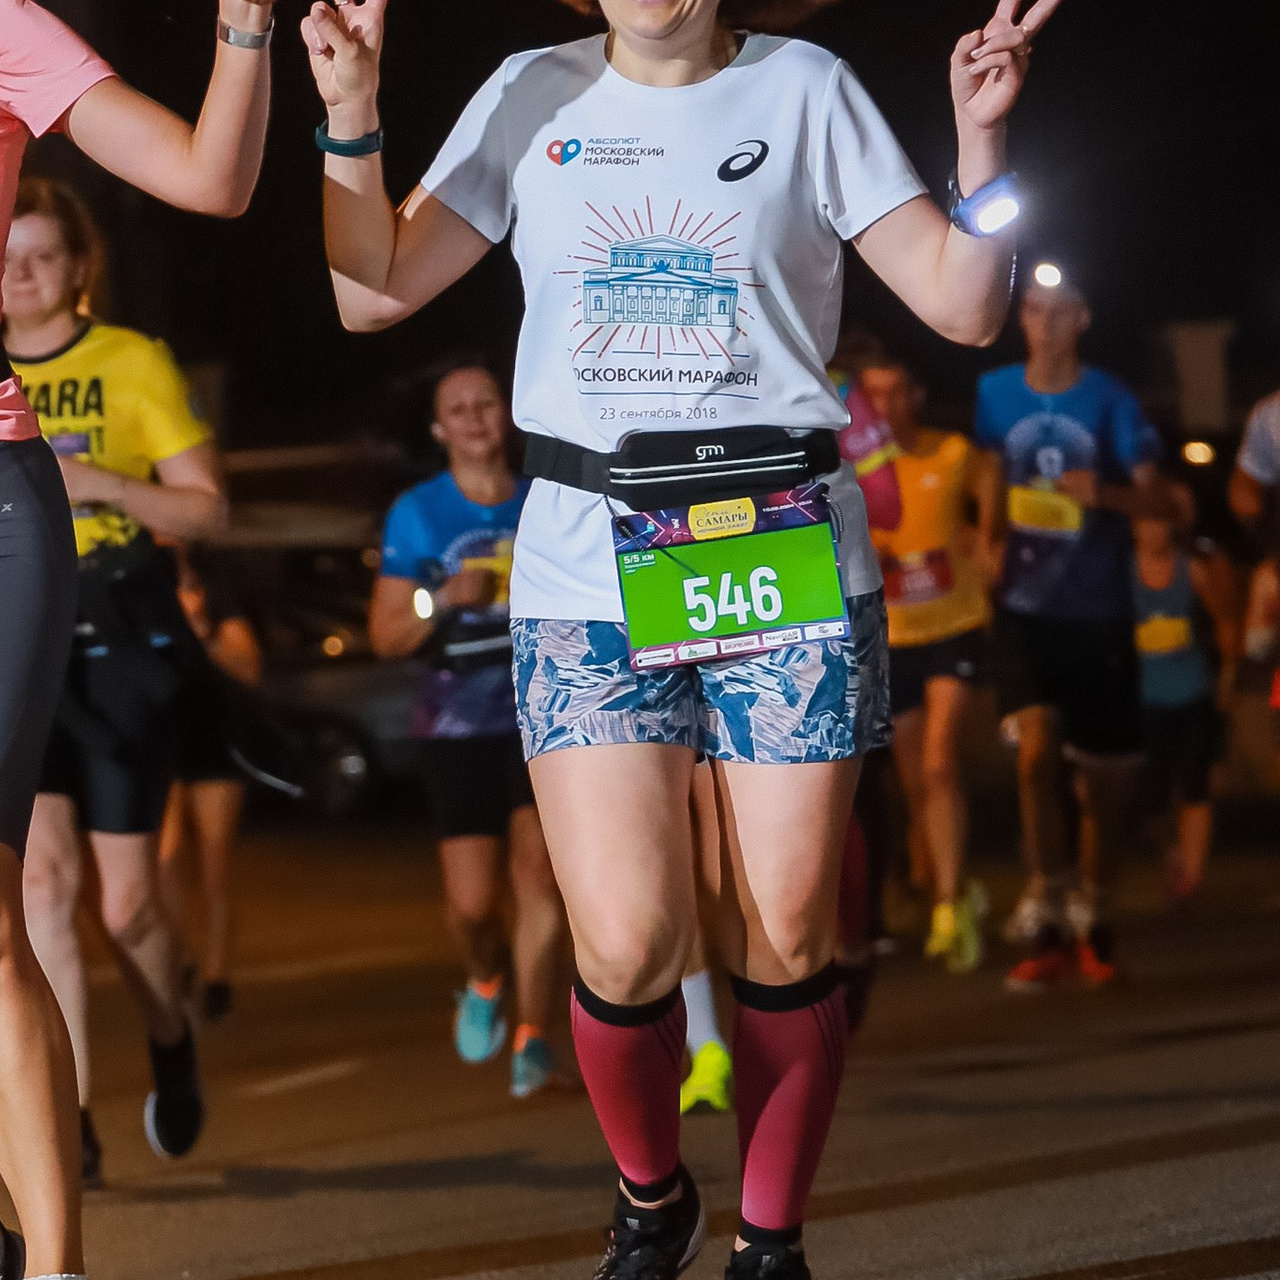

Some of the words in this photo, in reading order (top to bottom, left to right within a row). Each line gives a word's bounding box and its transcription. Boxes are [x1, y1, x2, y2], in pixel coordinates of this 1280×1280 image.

[587, 137, 641, 145] АБСОЛЮТ
[585, 147, 665, 157] МОСКОВСКИЙ
[583, 157, 640, 166] МАРАФОН
[678, 369, 758, 387] МАРАФОН
[21, 376, 103, 418] ARA
[599, 407, 616, 420] 23
[619, 407, 681, 420] сентября
[686, 407, 718, 420] 2018
[695, 445, 724, 461] gm
[696, 512, 748, 528] САМАРЫ
[683, 566, 783, 632] 546
